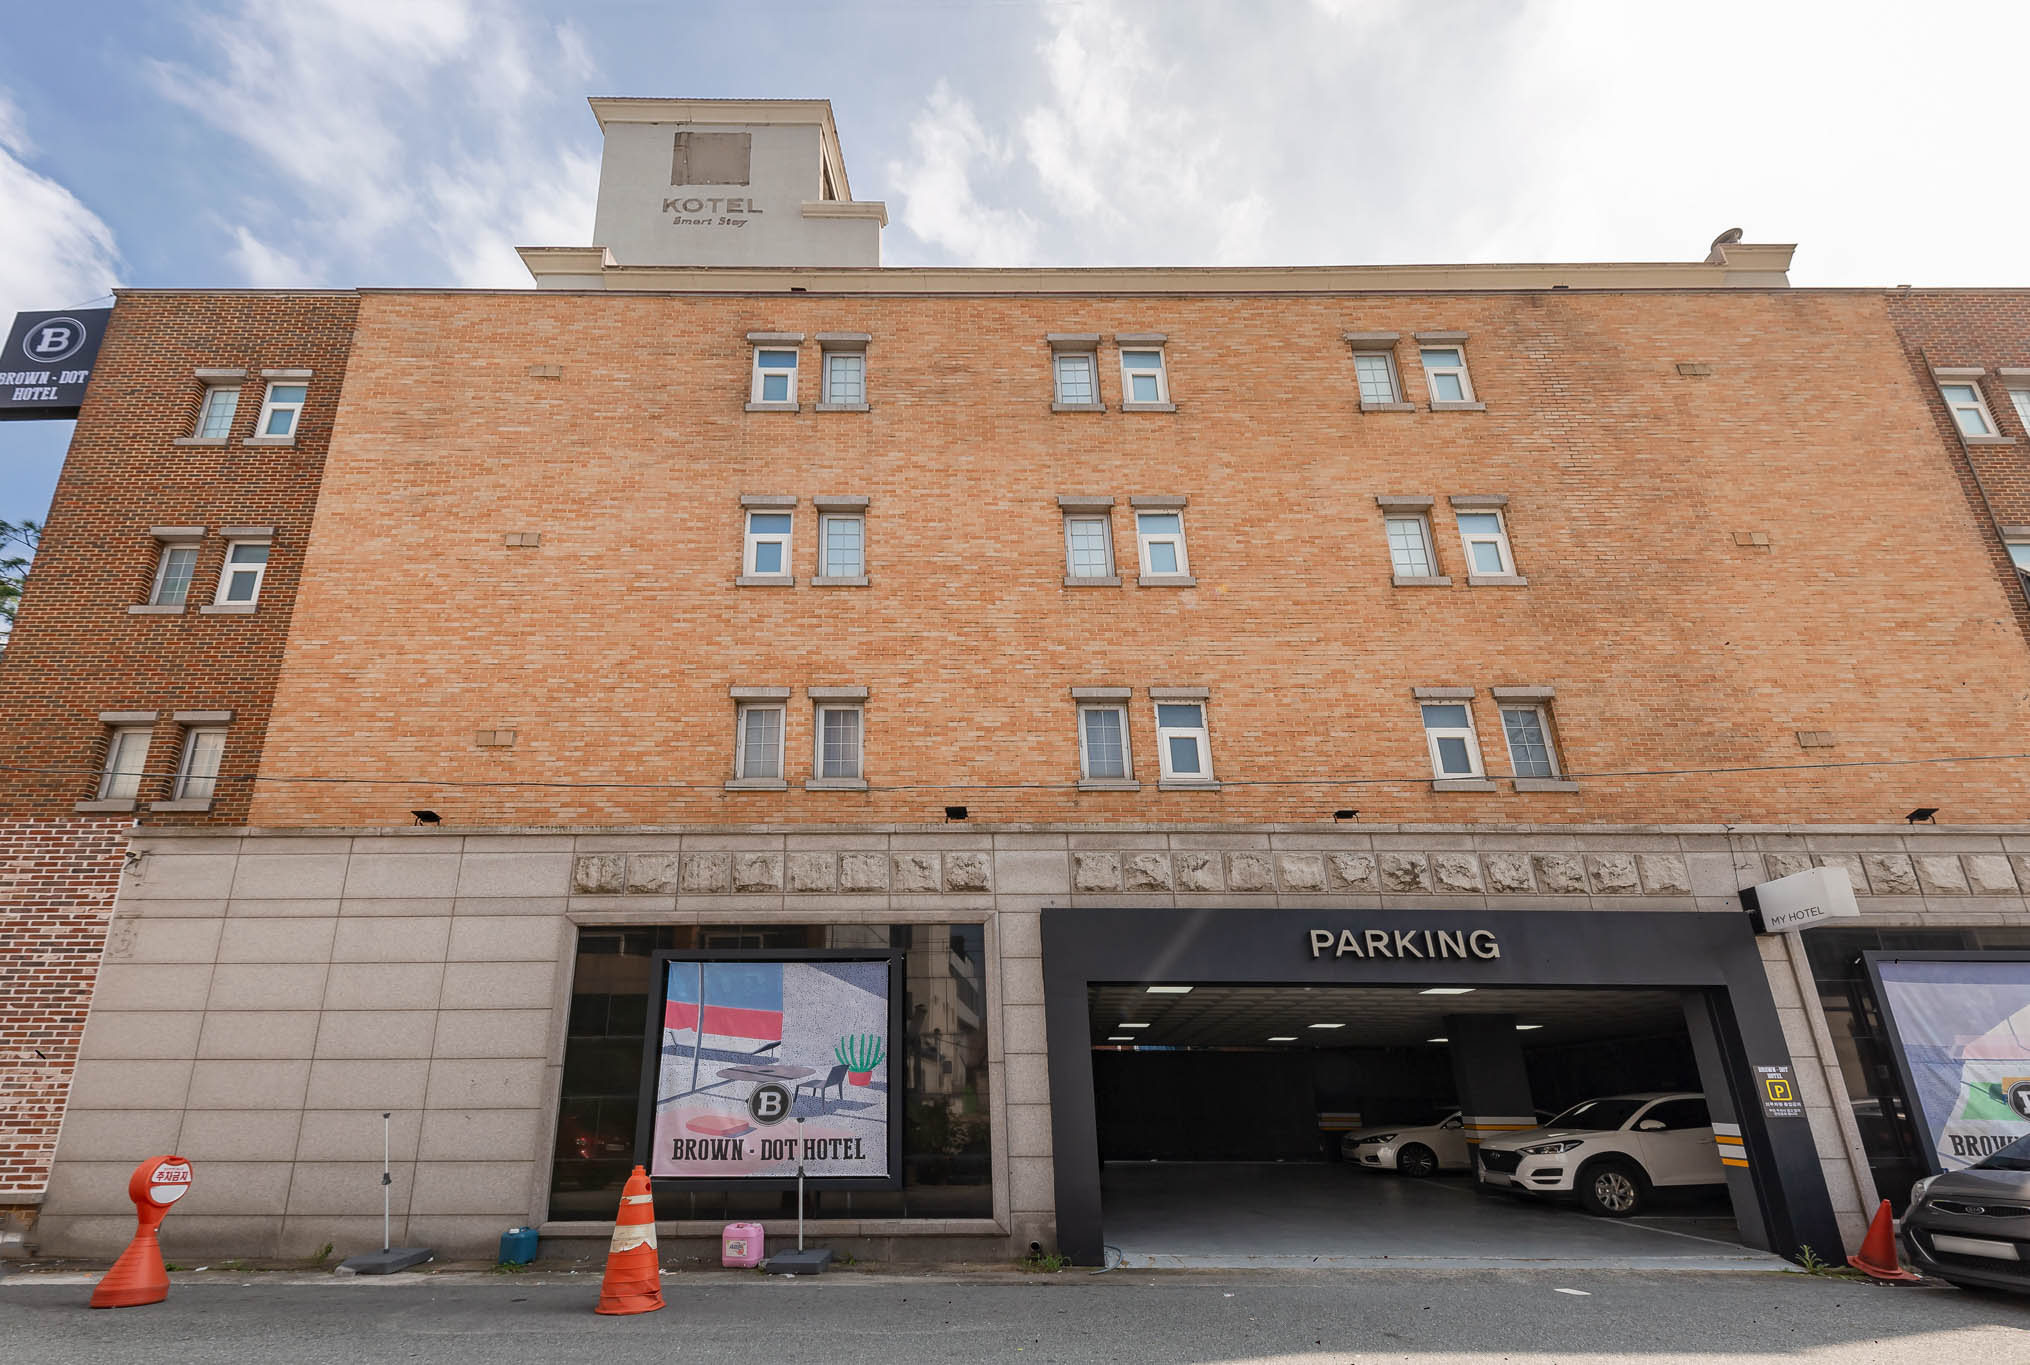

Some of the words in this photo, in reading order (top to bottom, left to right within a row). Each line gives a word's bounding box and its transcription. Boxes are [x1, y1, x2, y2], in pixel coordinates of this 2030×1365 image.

[662, 198, 763, 213] KOTEL
[673, 216, 712, 225] Smart
[718, 216, 748, 228] Stay
[36, 327, 71, 352] B
[0, 371, 50, 385] BROWN
[58, 370, 88, 384] DOT
[12, 387, 58, 401] HOTEL
[1771, 914, 1786, 926] MY
[1788, 906, 1824, 922] HOTEL
[1310, 929, 1501, 959] PARKING
[1774, 1085, 1785, 1098] P
[758, 1091, 781, 1116] B
[672, 1138, 744, 1161] BROWN
[760, 1138, 798, 1161] DOT
[803, 1138, 866, 1161] HOTEL
[156, 1171, 189, 1182] 주차금지
